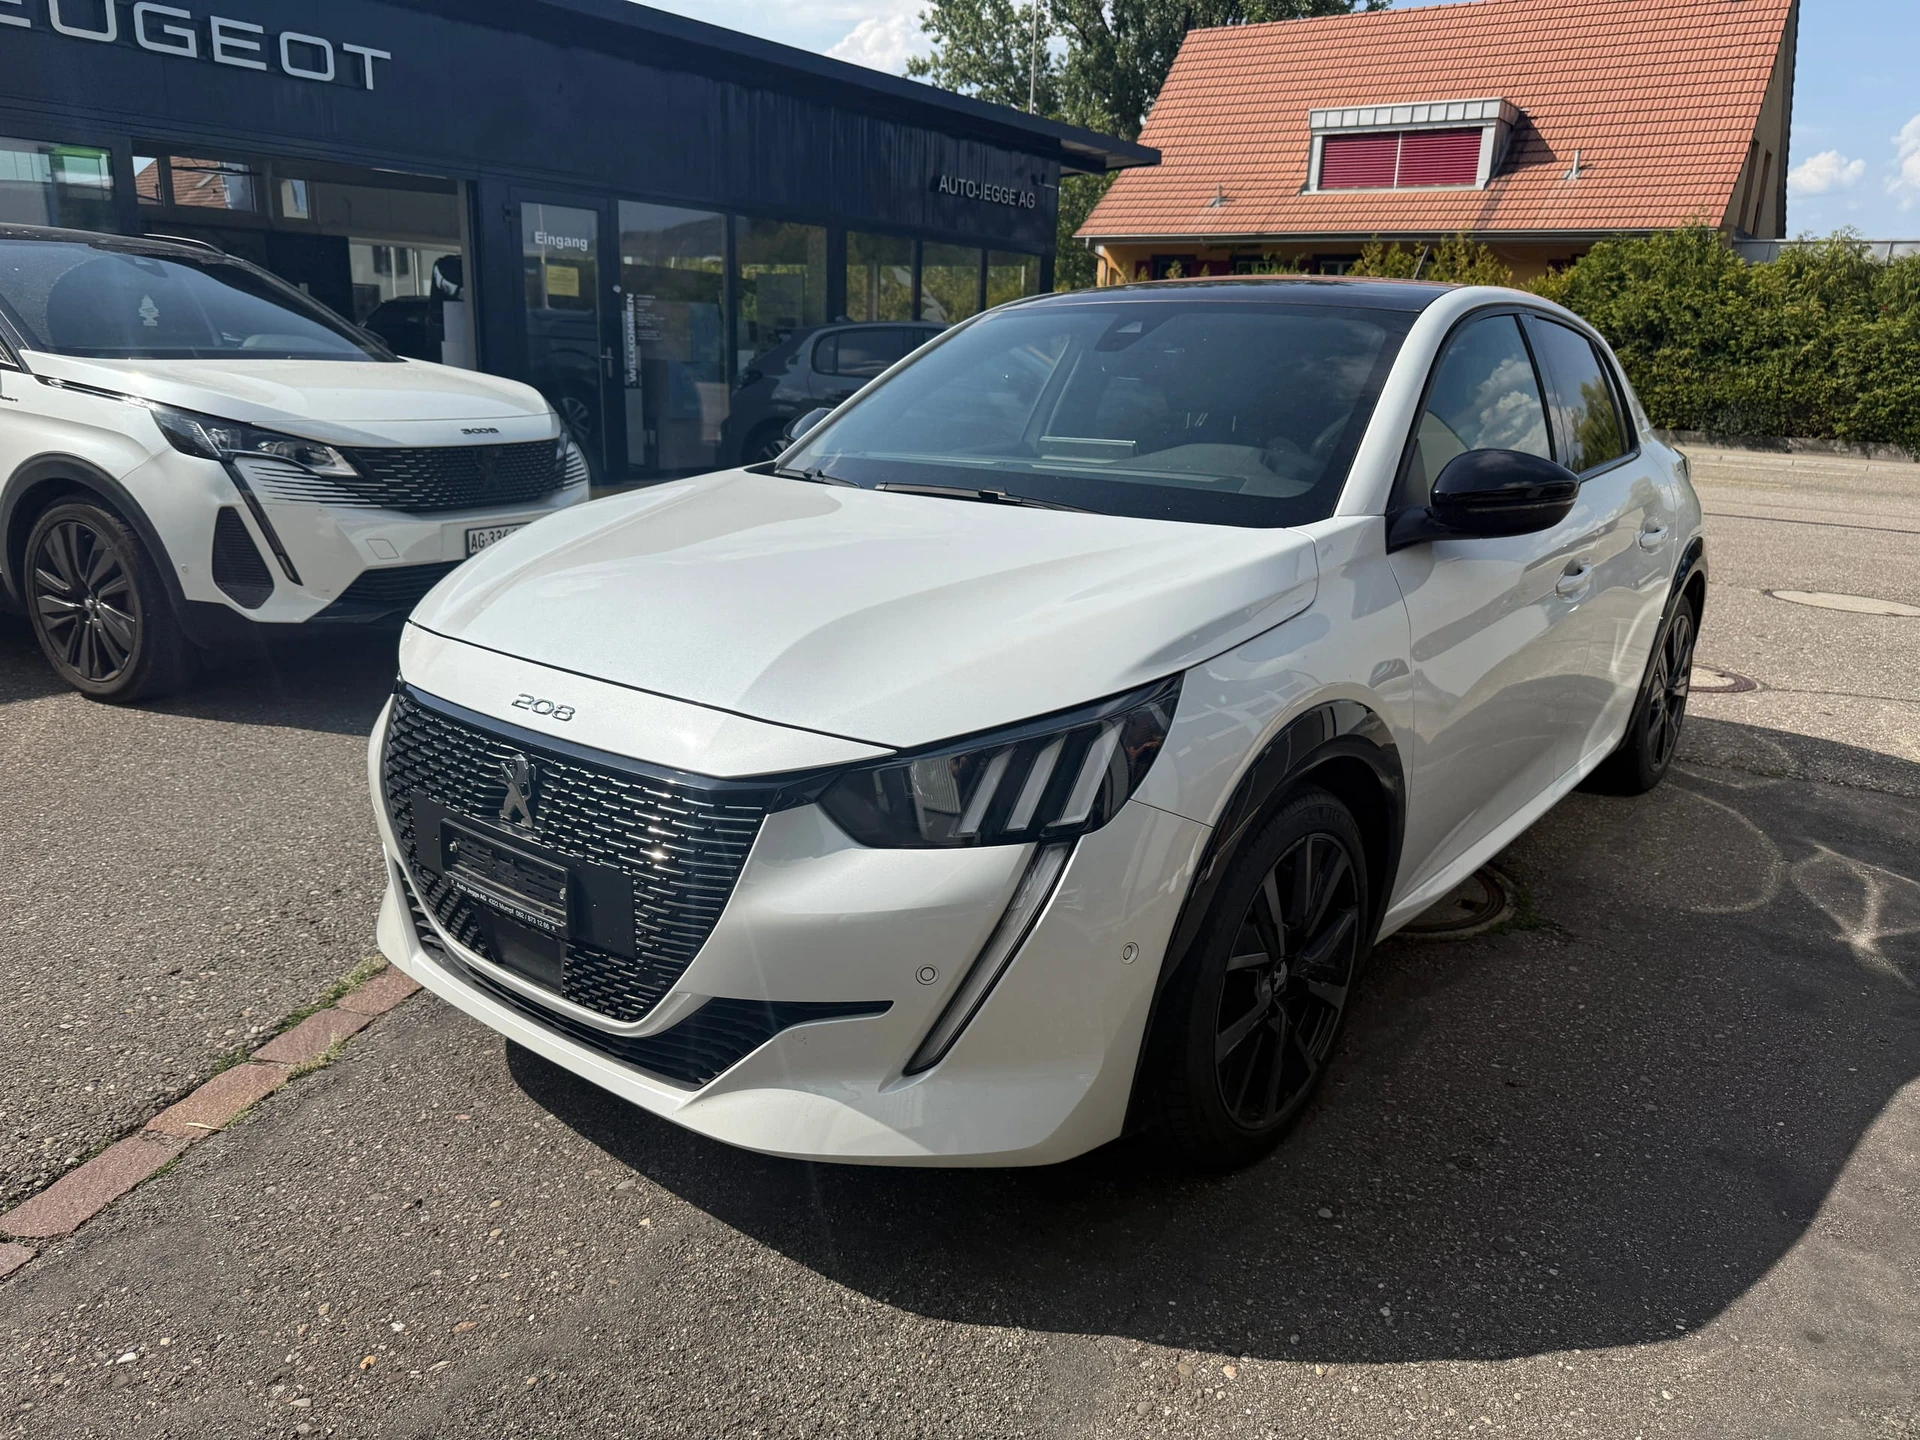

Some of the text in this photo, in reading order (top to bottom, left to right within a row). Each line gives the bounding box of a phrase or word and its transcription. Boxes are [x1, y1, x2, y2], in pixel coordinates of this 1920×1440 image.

[938, 175, 1036, 209] AUTO-JEGGE AG
[534, 231, 589, 252] Eingang
[626, 293, 637, 383] WILLKOMMEN
[460, 427, 500, 435] 3008
[511, 693, 576, 722] 208
[456, 882, 467, 892] Auto
[480, 893, 488, 902] AG
